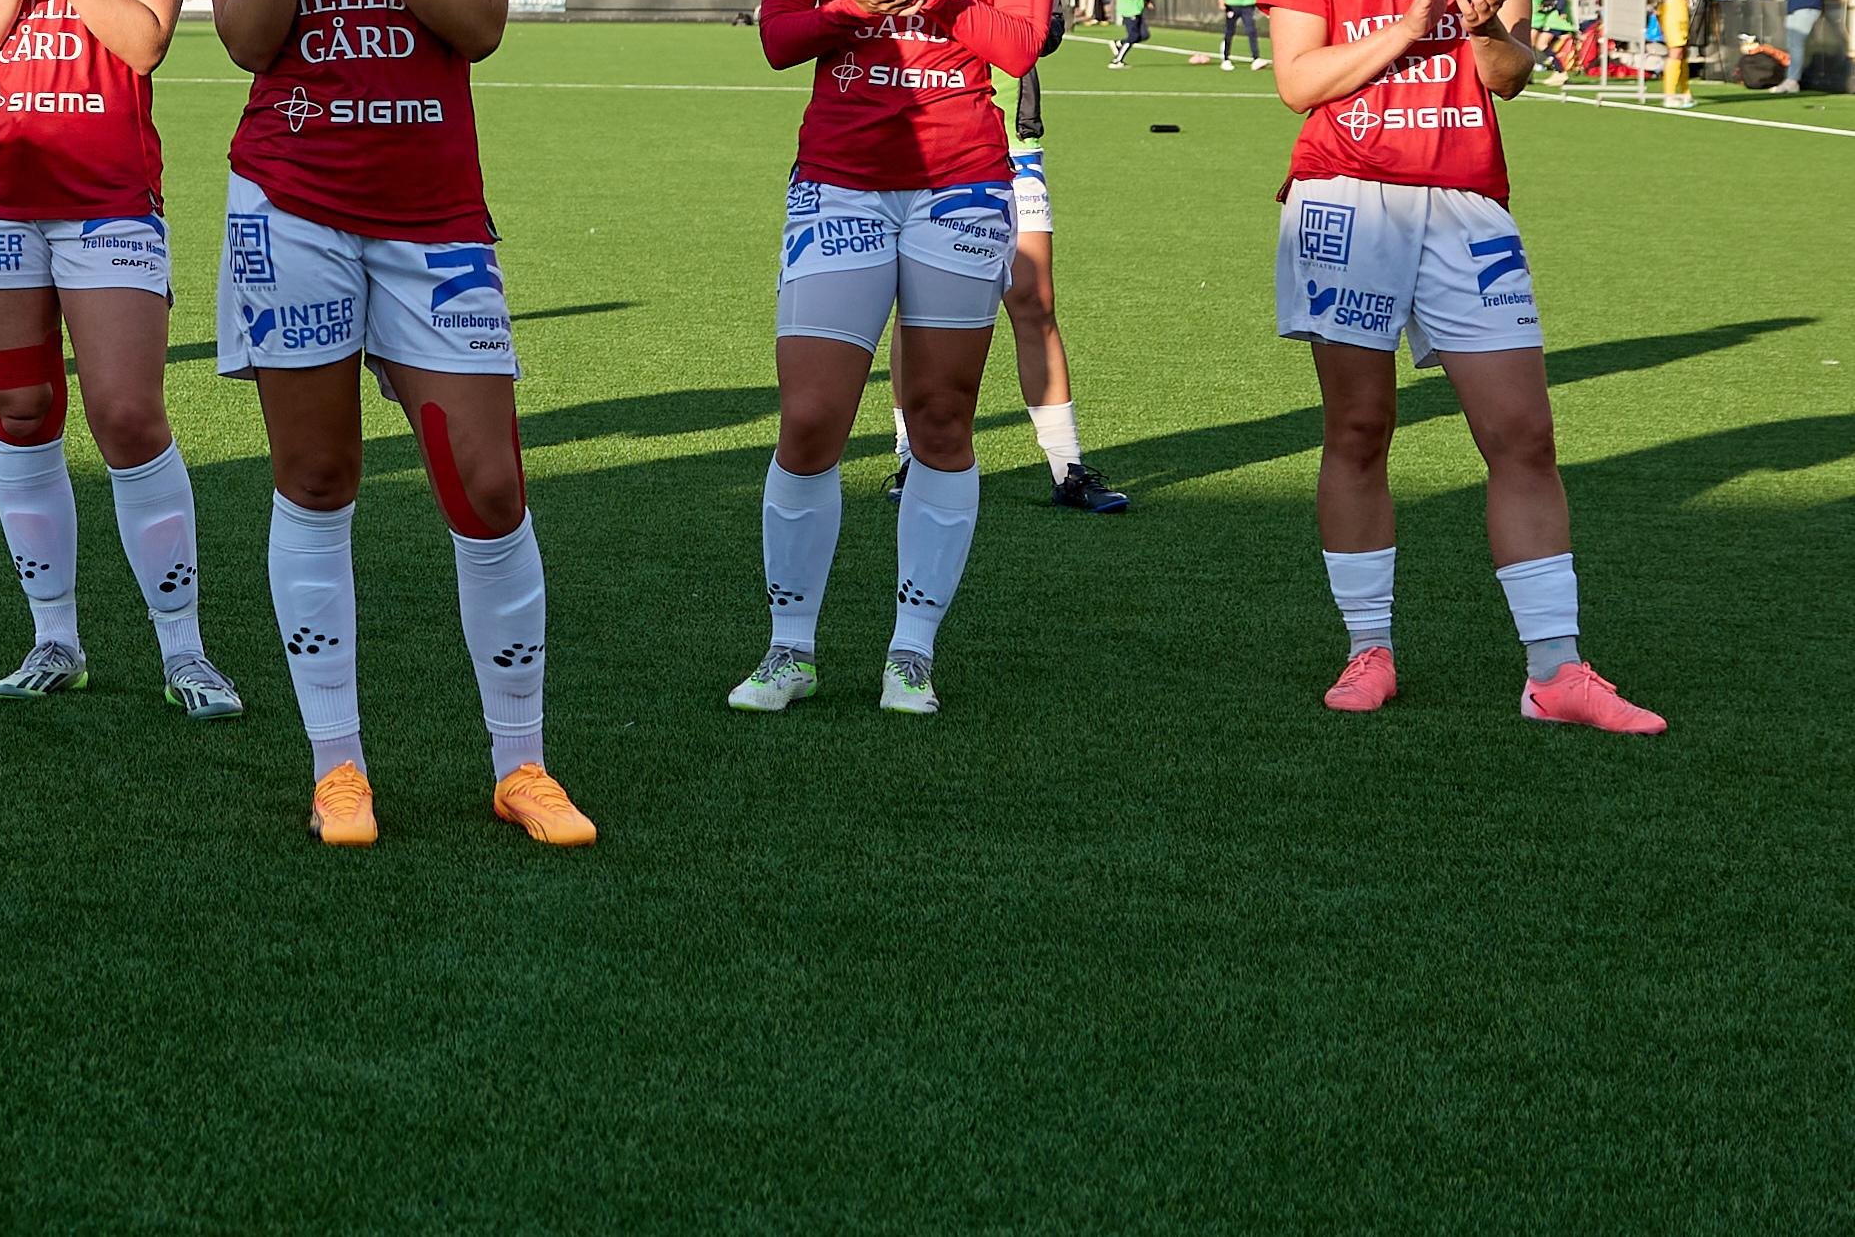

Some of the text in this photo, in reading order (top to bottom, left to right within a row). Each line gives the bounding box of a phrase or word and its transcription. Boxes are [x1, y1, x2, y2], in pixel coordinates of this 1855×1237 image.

[300, 16, 415, 63] GÅRD
[818, 218, 884, 240] INTER
[82, 236, 144, 252] Trelleborgs
[821, 233, 886, 257] SPORT
[953, 243, 990, 258] CRAFT
[111, 258, 149, 269] CRAFT
[1340, 287, 1395, 313] INTER
[280, 297, 354, 327] INTER
[432, 314, 500, 330] Trelleborgs
[1334, 307, 1391, 333] SPORT
[283, 319, 353, 350] SPORT
[469, 340, 505, 350] CRAFT
